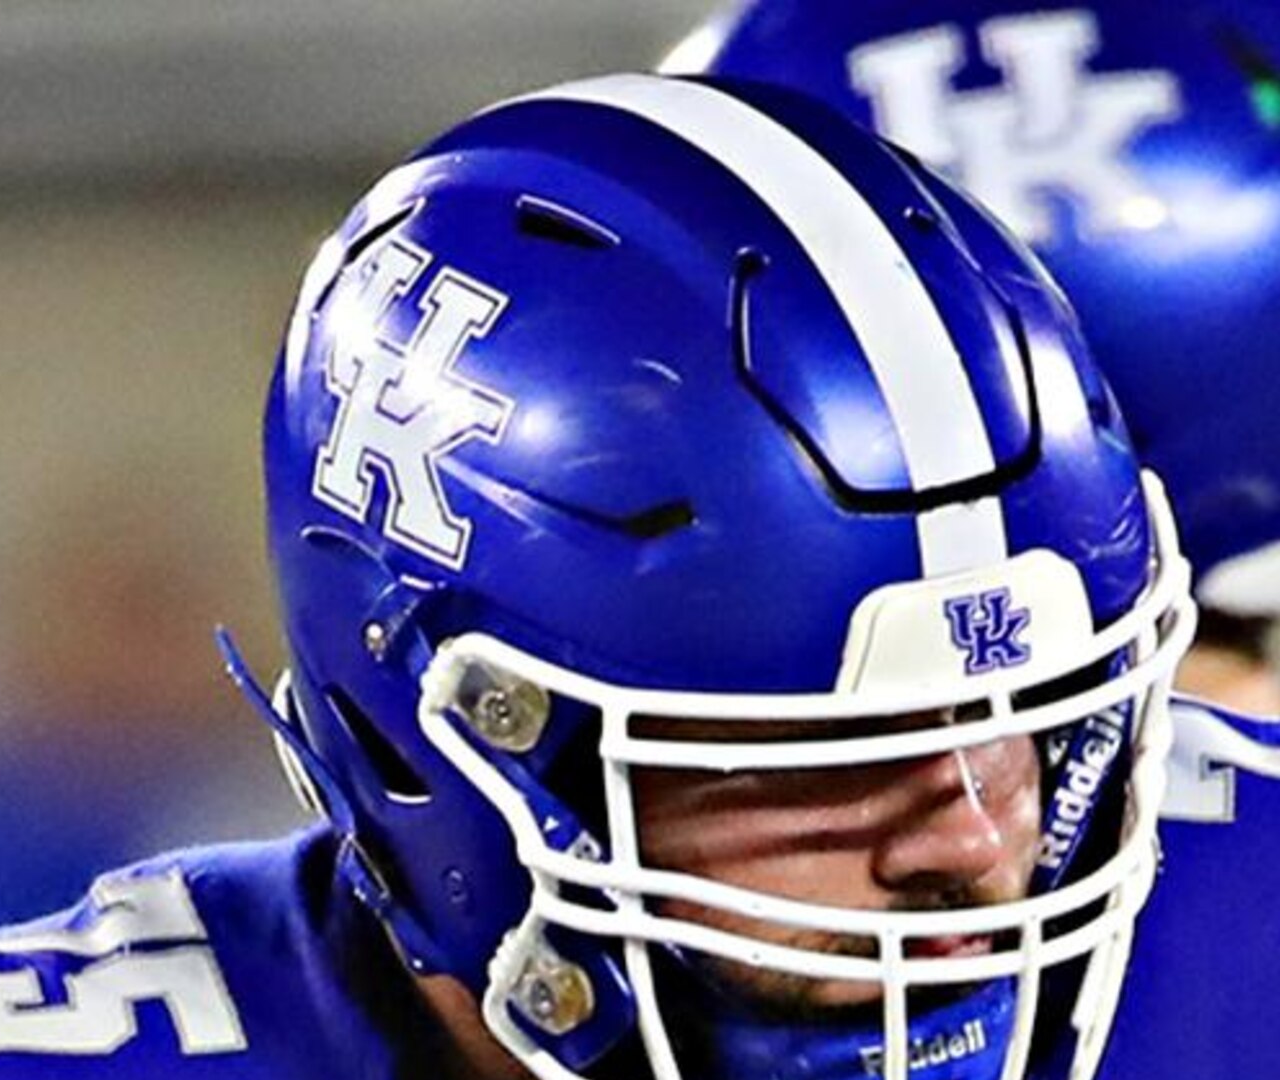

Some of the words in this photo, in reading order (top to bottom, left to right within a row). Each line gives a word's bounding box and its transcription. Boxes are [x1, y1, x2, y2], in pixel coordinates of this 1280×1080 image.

[845, 7, 1188, 248] UK
[311, 236, 517, 572] UK
[943, 585, 1032, 677] UK
[858, 1018, 986, 1080] Rddell
